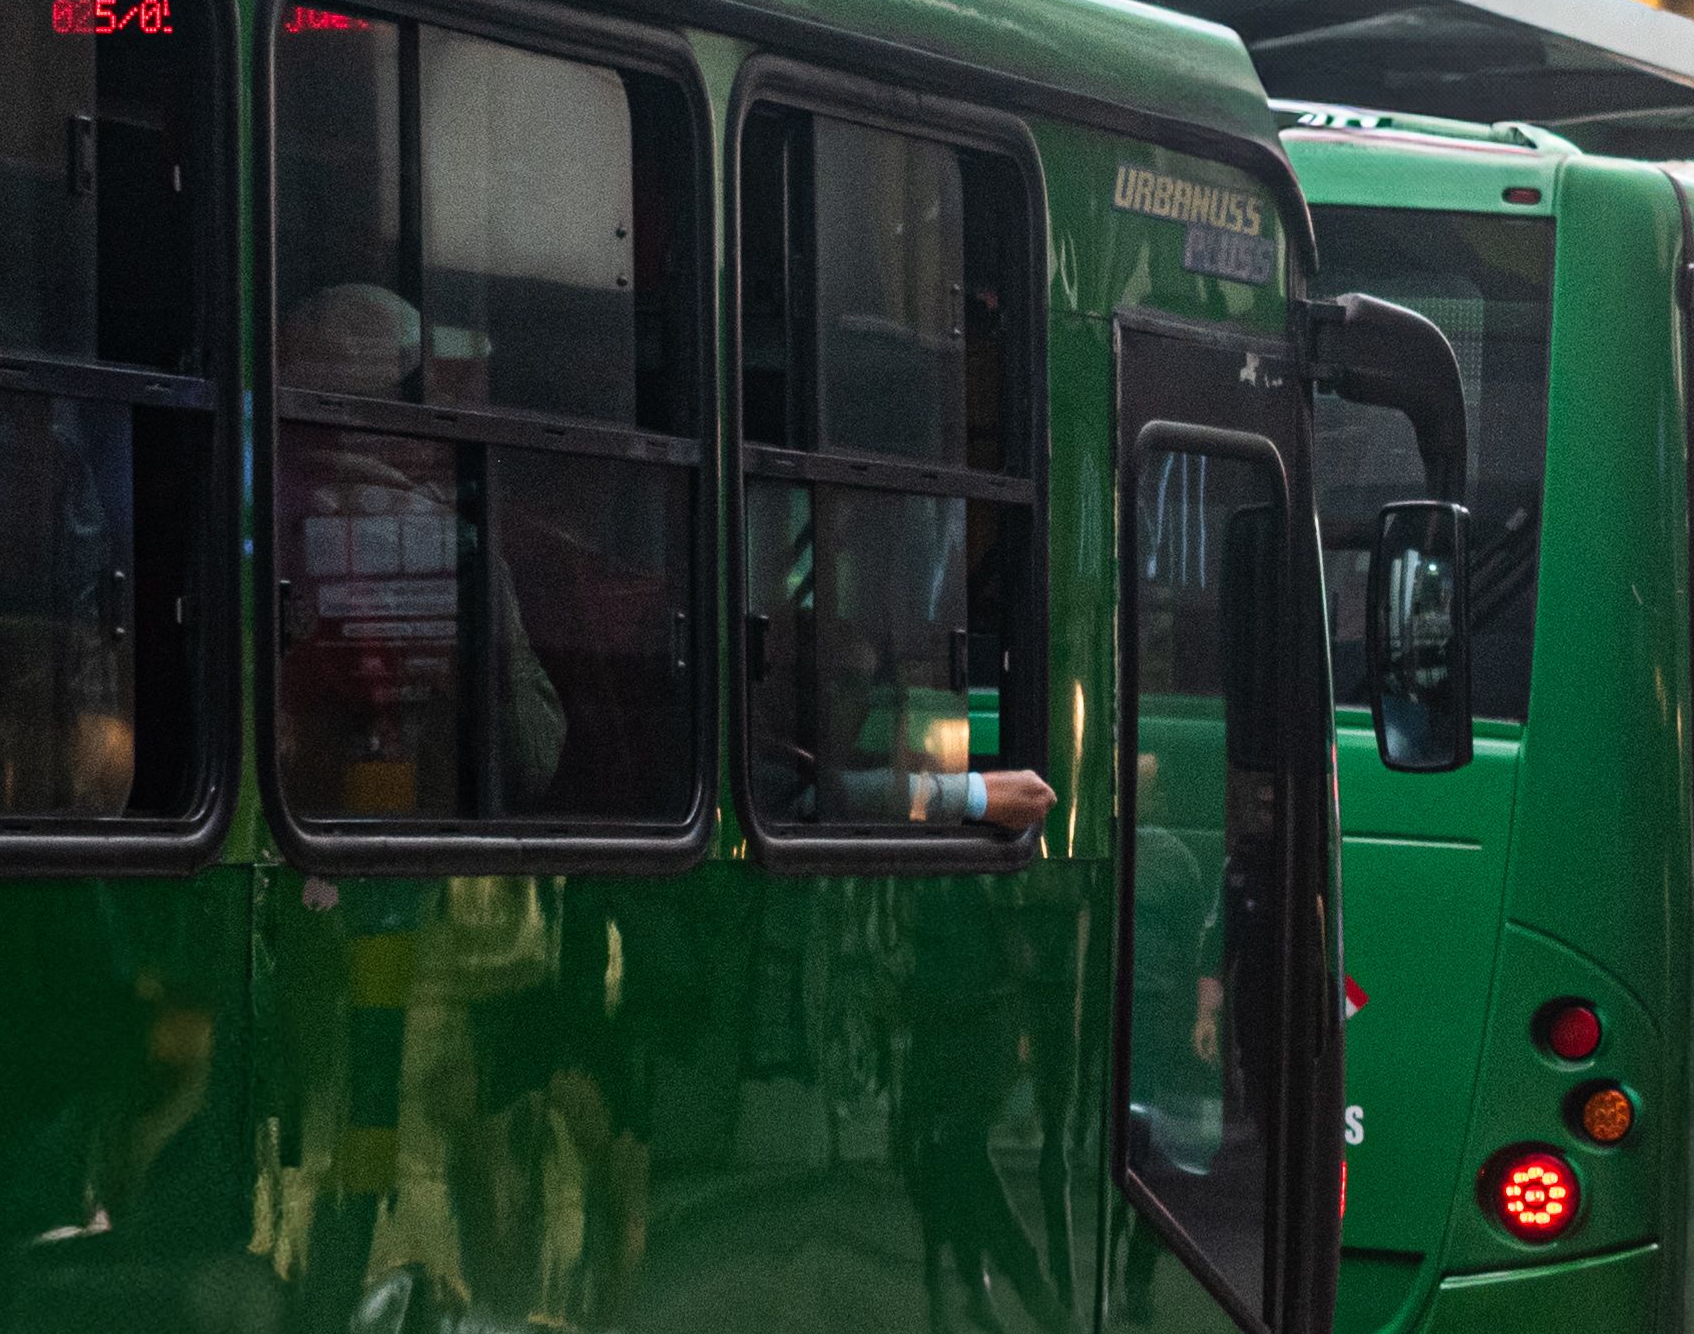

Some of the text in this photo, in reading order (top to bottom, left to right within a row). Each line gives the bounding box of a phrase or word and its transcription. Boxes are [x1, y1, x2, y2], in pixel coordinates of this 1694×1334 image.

[1113, 165, 1262, 237] URBANUSS
[1184, 227, 1275, 284] PLUSS
[1344, 1104, 1365, 1146] S
